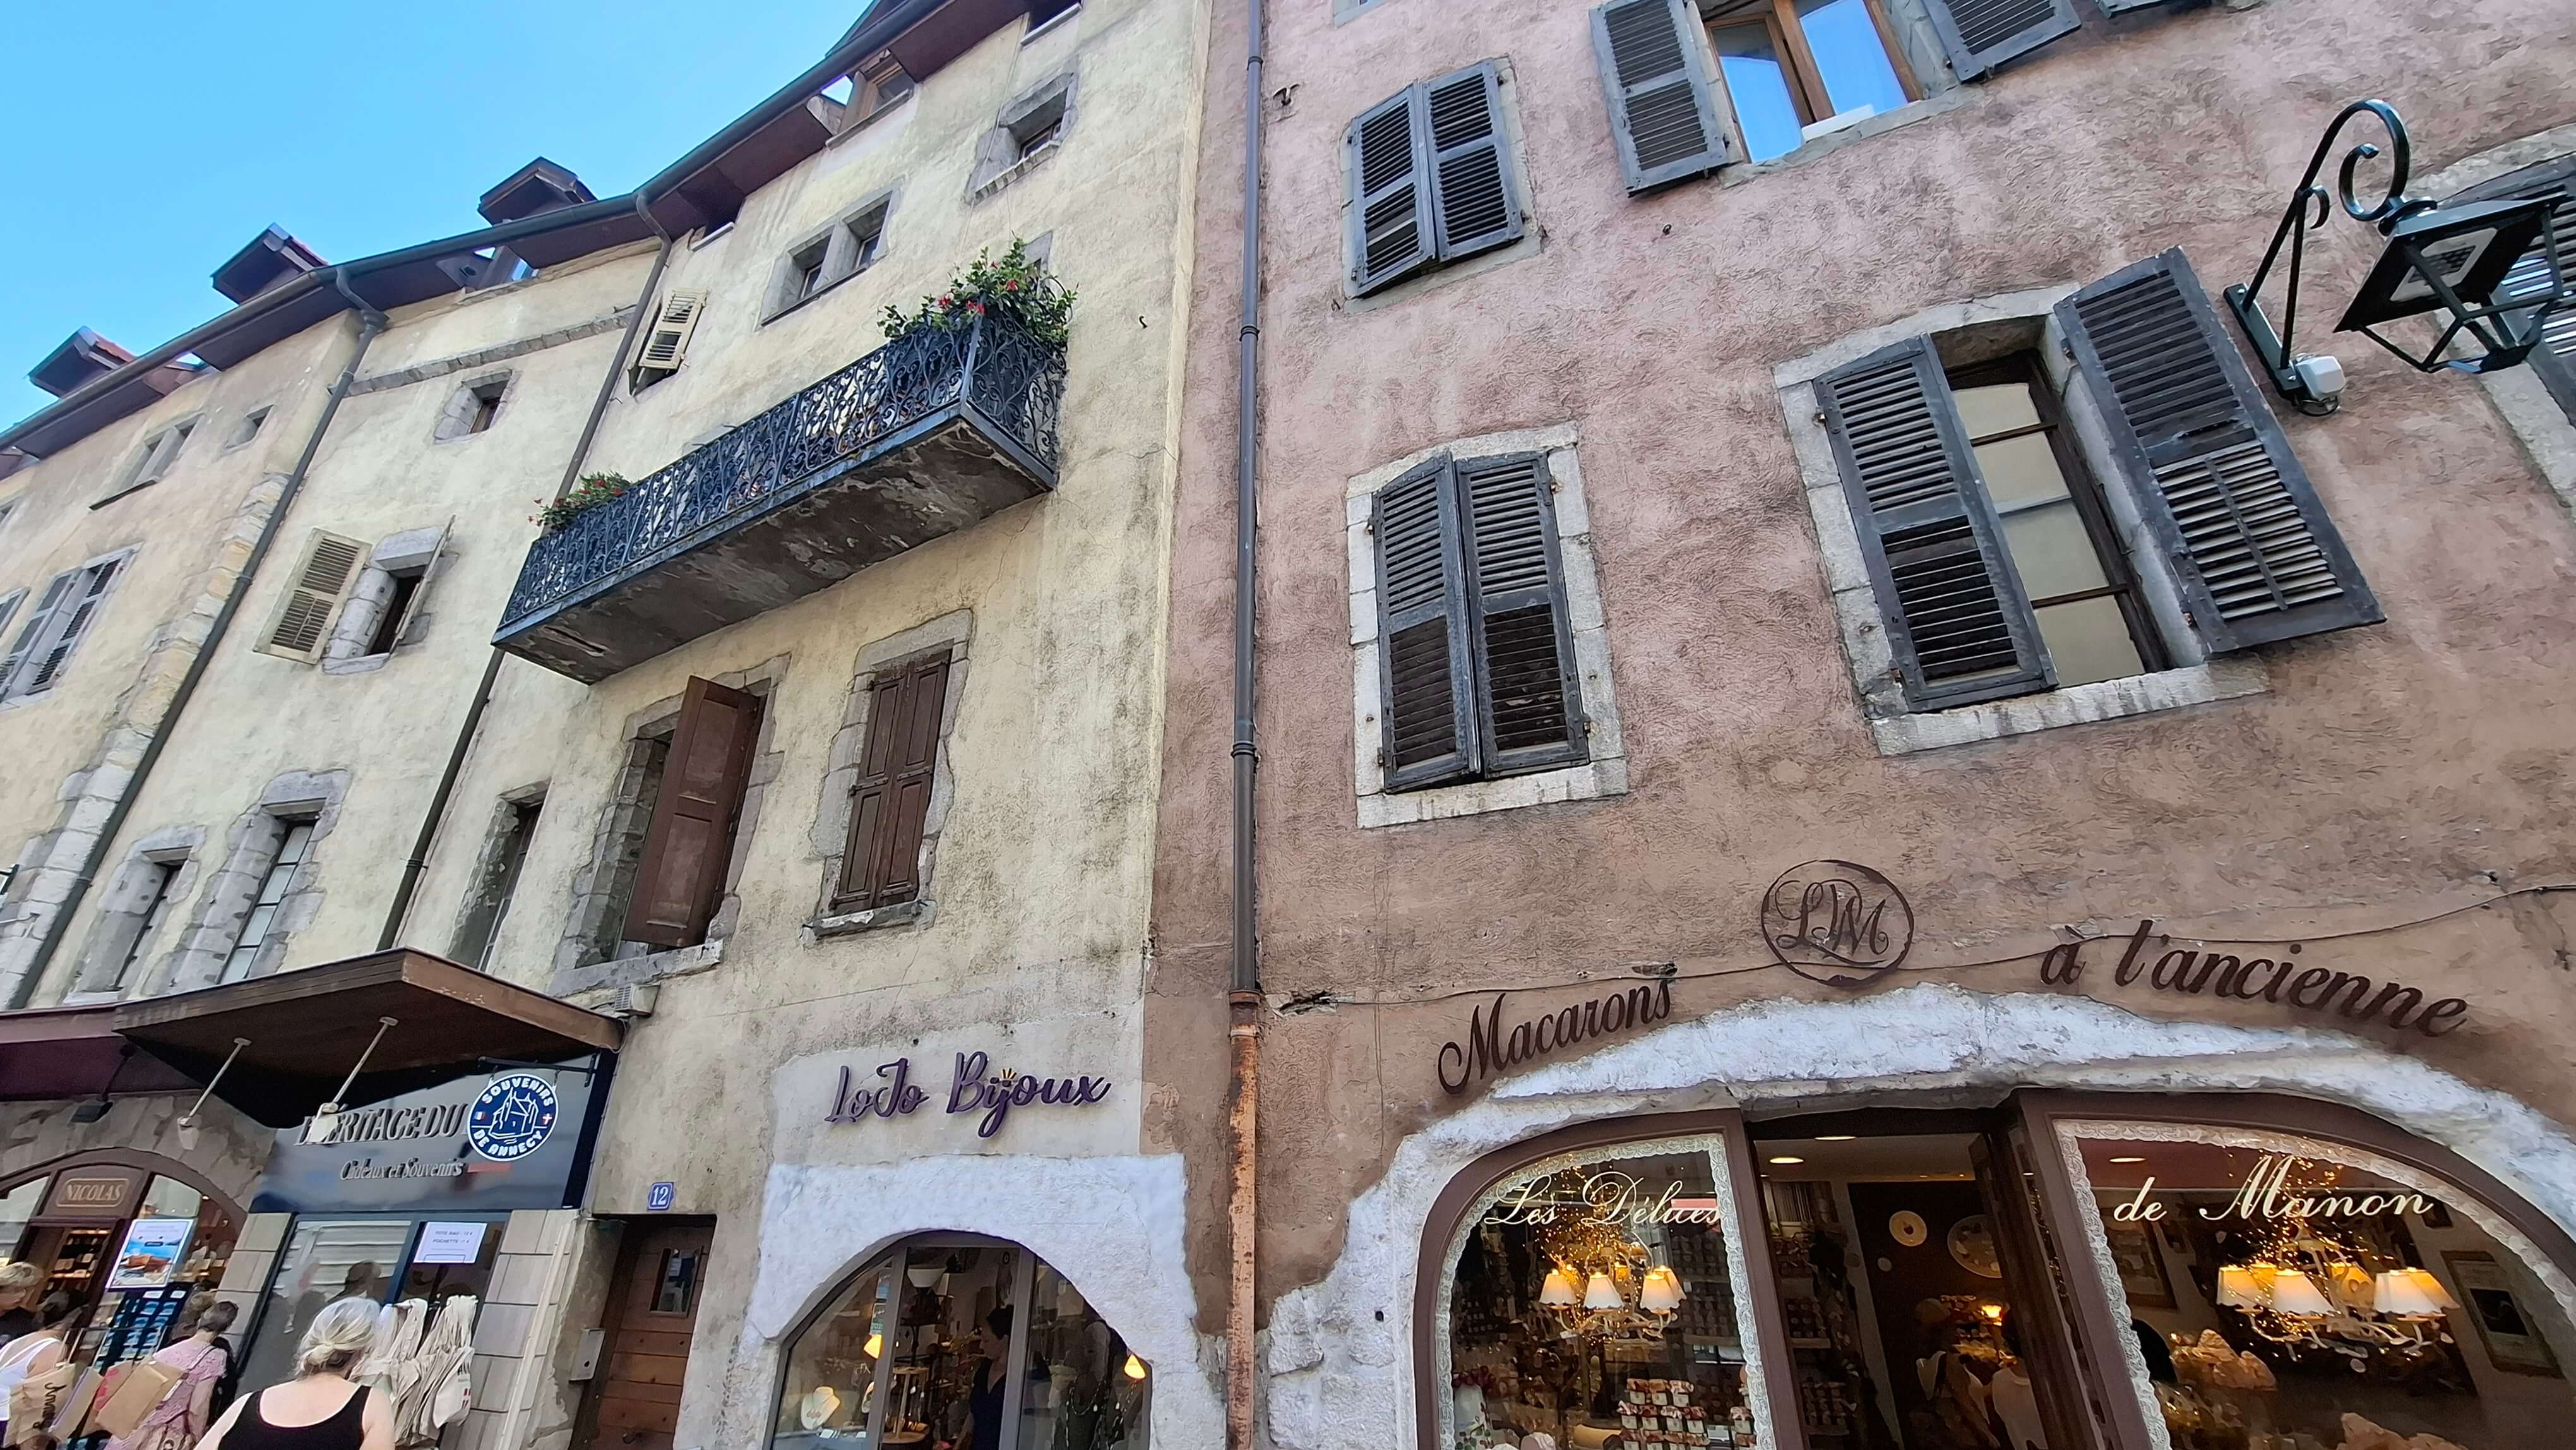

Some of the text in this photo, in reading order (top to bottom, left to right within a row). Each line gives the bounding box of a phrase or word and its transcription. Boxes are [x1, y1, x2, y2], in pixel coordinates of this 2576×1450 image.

[2115, 919, 2468, 1037] l'ancienne
[1437, 978, 1671, 1096] Macarons
[482, 1077, 554, 1106] SOUVENIRS
[824, 1051, 1112, 1139] LoJo Bijoux
[423, 1104, 468, 1137] DU
[474, 1129, 542, 1156] DE ANNECY
[388, 1163, 404, 1178] et
[402, 1157, 463, 1178] Souvenirs
[66, 1184, 123, 1201] NICOLAS
[652, 1187, 669, 1205] 12
[1482, 1171, 1722, 1228] Les Délices
[2113, 1154, 2434, 1223] de Manon
